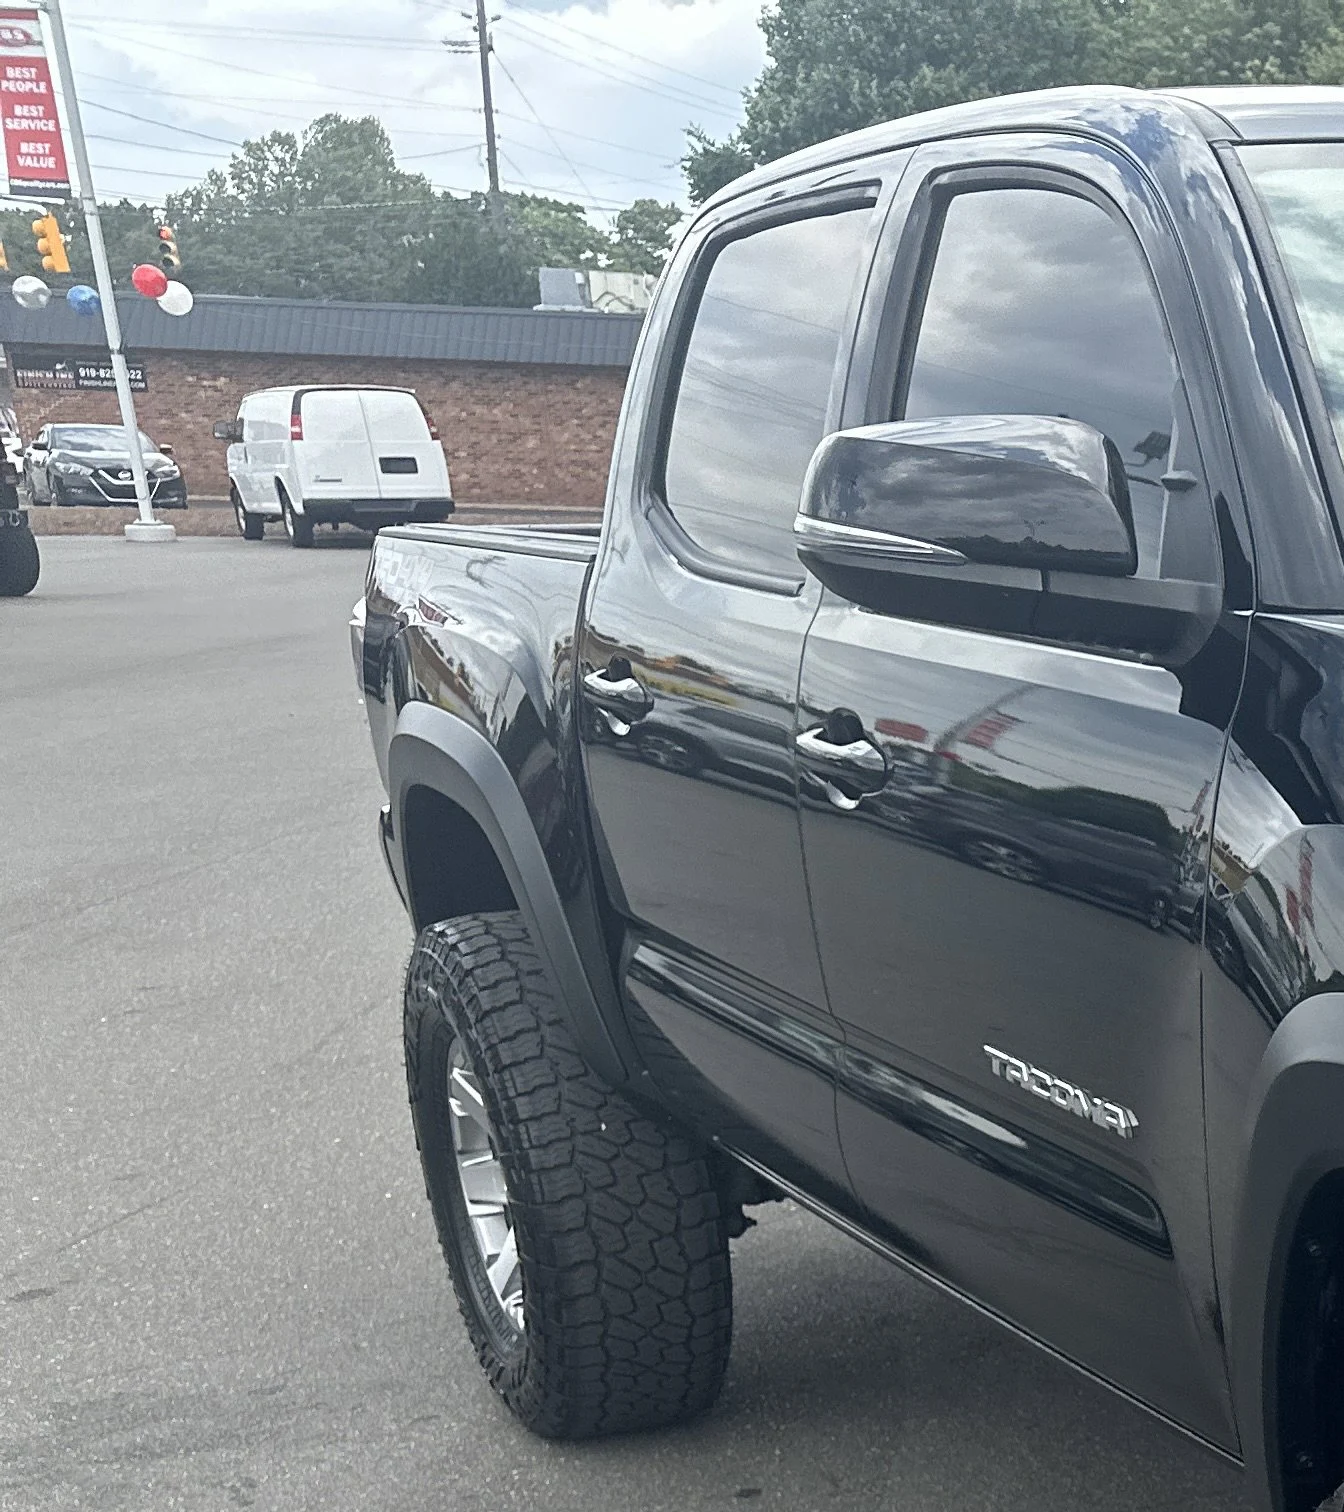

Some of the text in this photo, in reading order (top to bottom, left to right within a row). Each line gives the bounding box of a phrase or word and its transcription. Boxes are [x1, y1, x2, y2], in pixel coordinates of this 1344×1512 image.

[6, 66, 38, 79] BEST
[1, 80, 48, 93] PEOPLE
[14, 104, 46, 118] BEST
[5, 118, 57, 132] SERVICE
[20, 142, 52, 155] BEST
[17, 155, 57, 169] VALUE
[983, 1043, 1139, 1139] TACOMA
